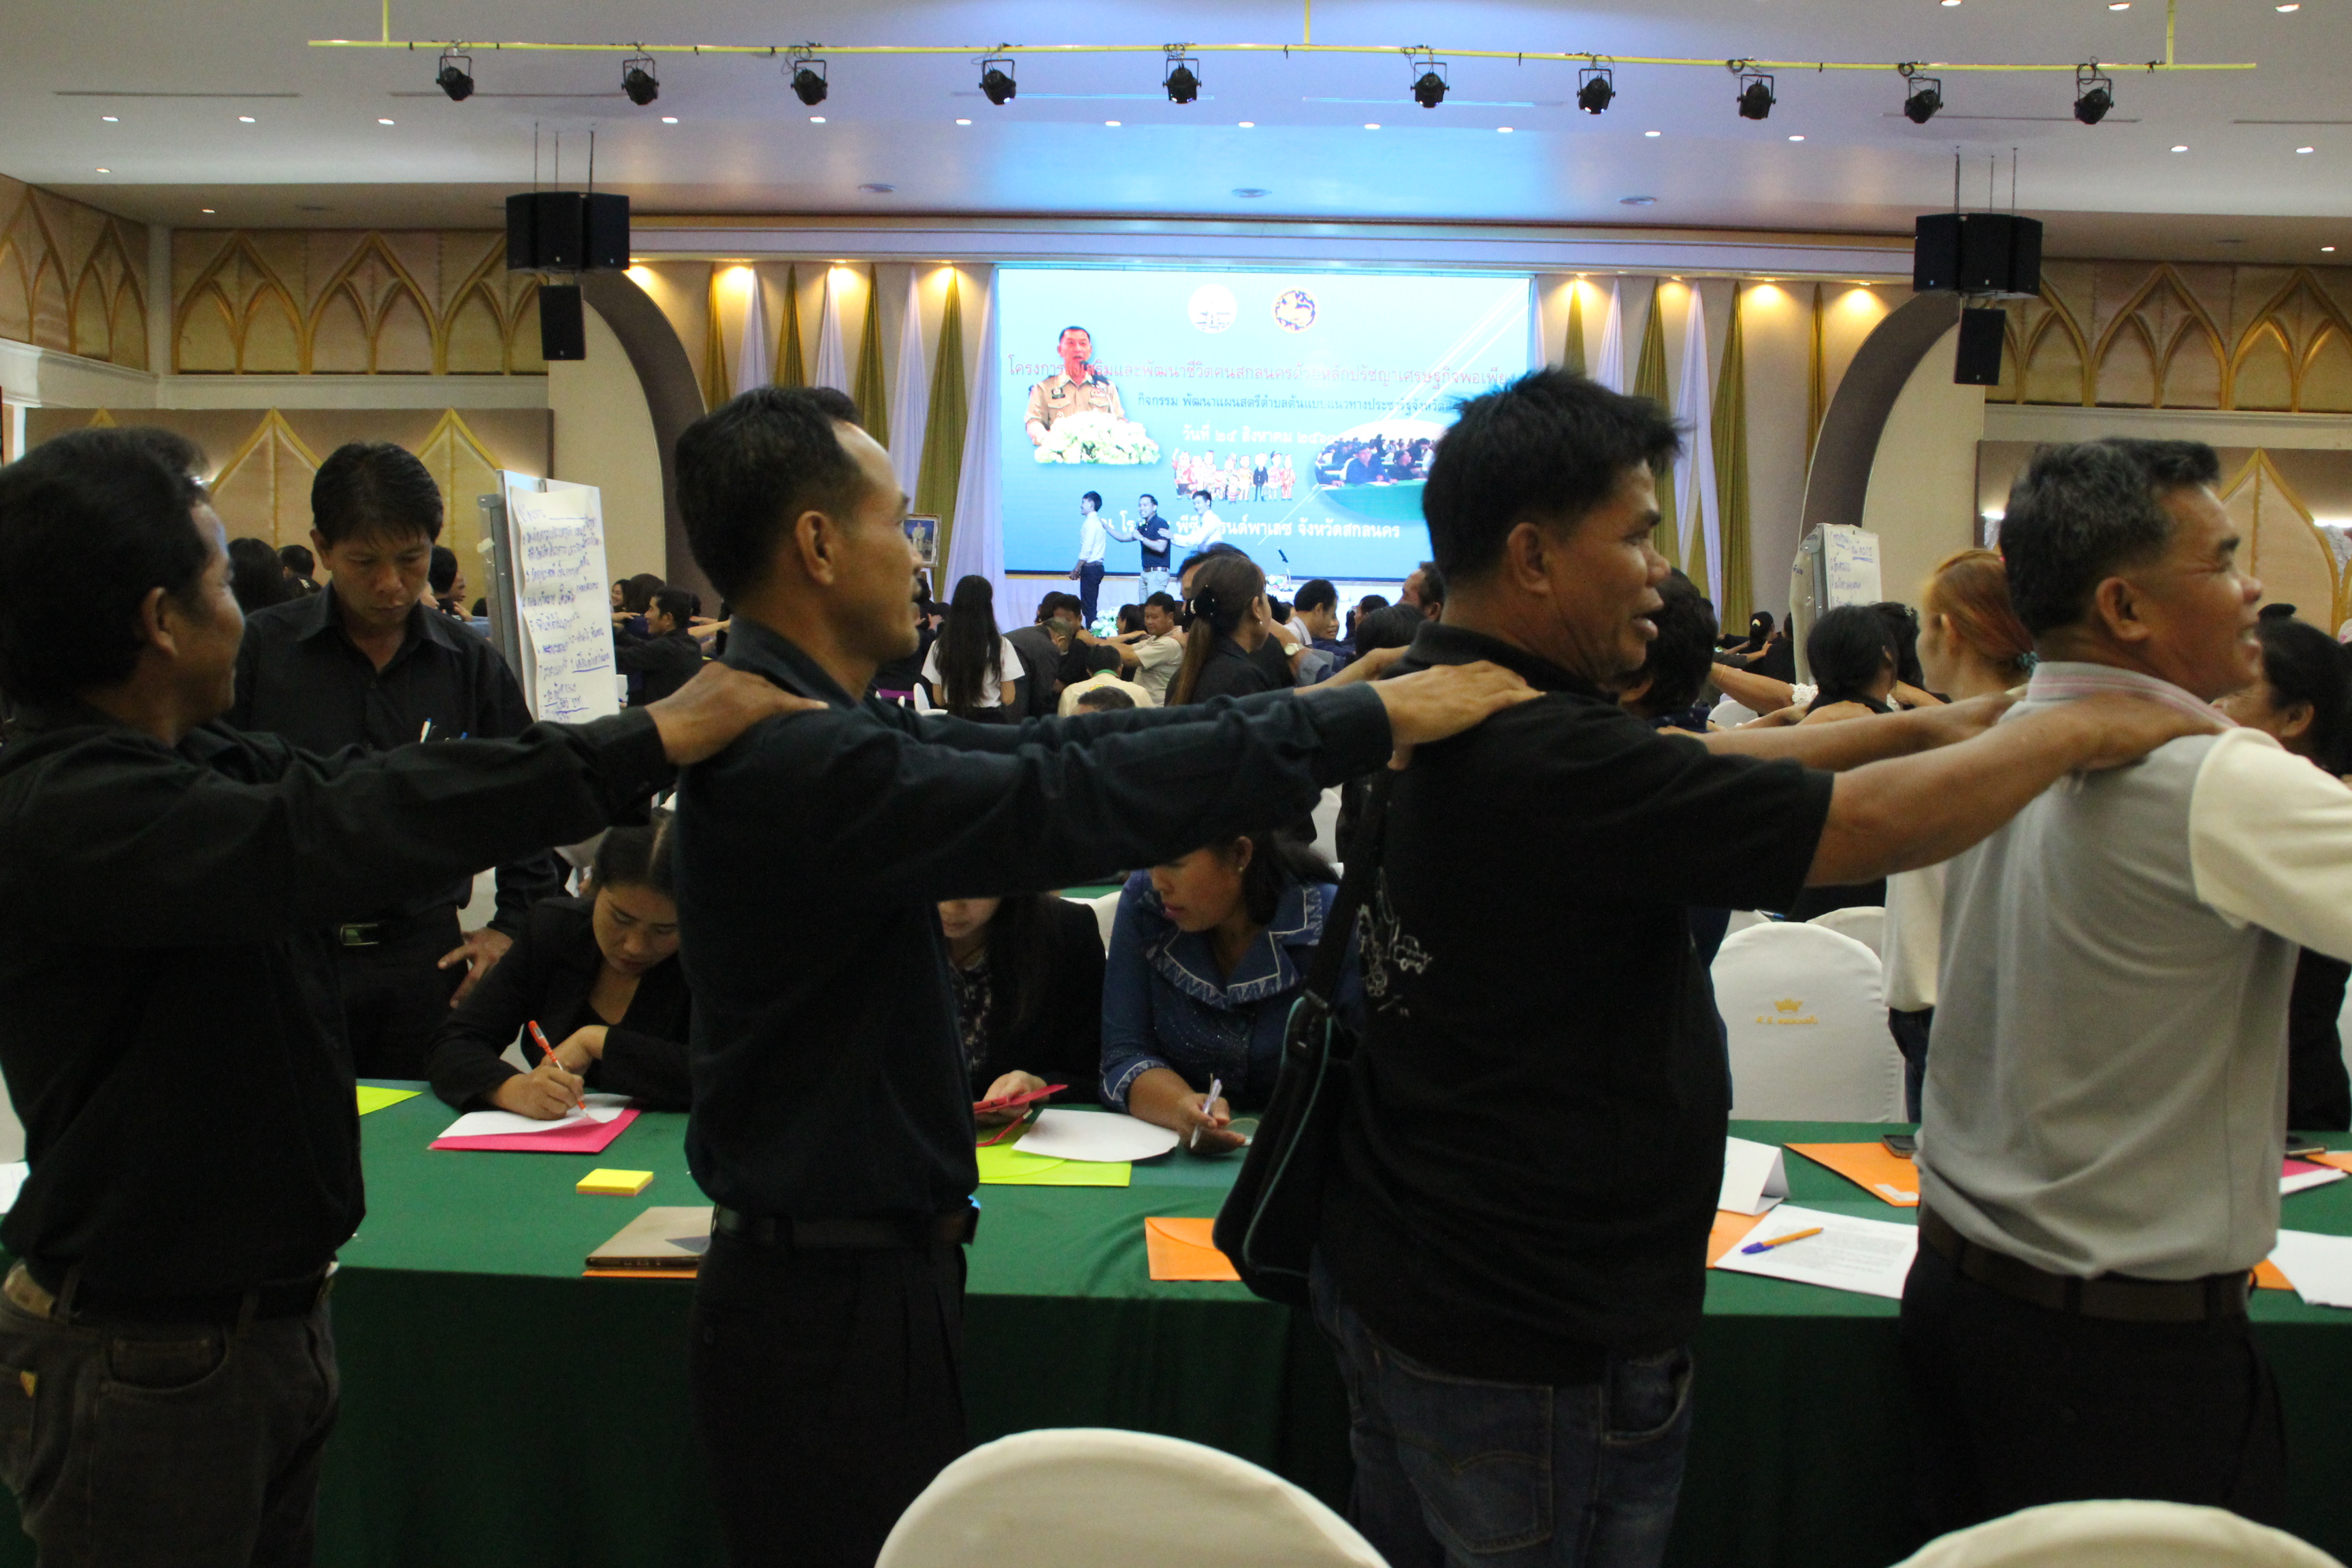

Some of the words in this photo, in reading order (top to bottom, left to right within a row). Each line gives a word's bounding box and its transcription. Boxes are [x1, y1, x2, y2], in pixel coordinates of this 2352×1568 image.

[1137, 391, 1178, 406] กิจกรรม
[1182, 392, 1456, 416] พัฒนาแผนสตรีตำบลต้นแบบแนวทางประชารัฐจังหวัดส
[1182, 420, 1211, 442] วันที่
[1241, 425, 1292, 443] สิงหาคม
[1298, 517, 1401, 538] จังหวัดสกลนคร
